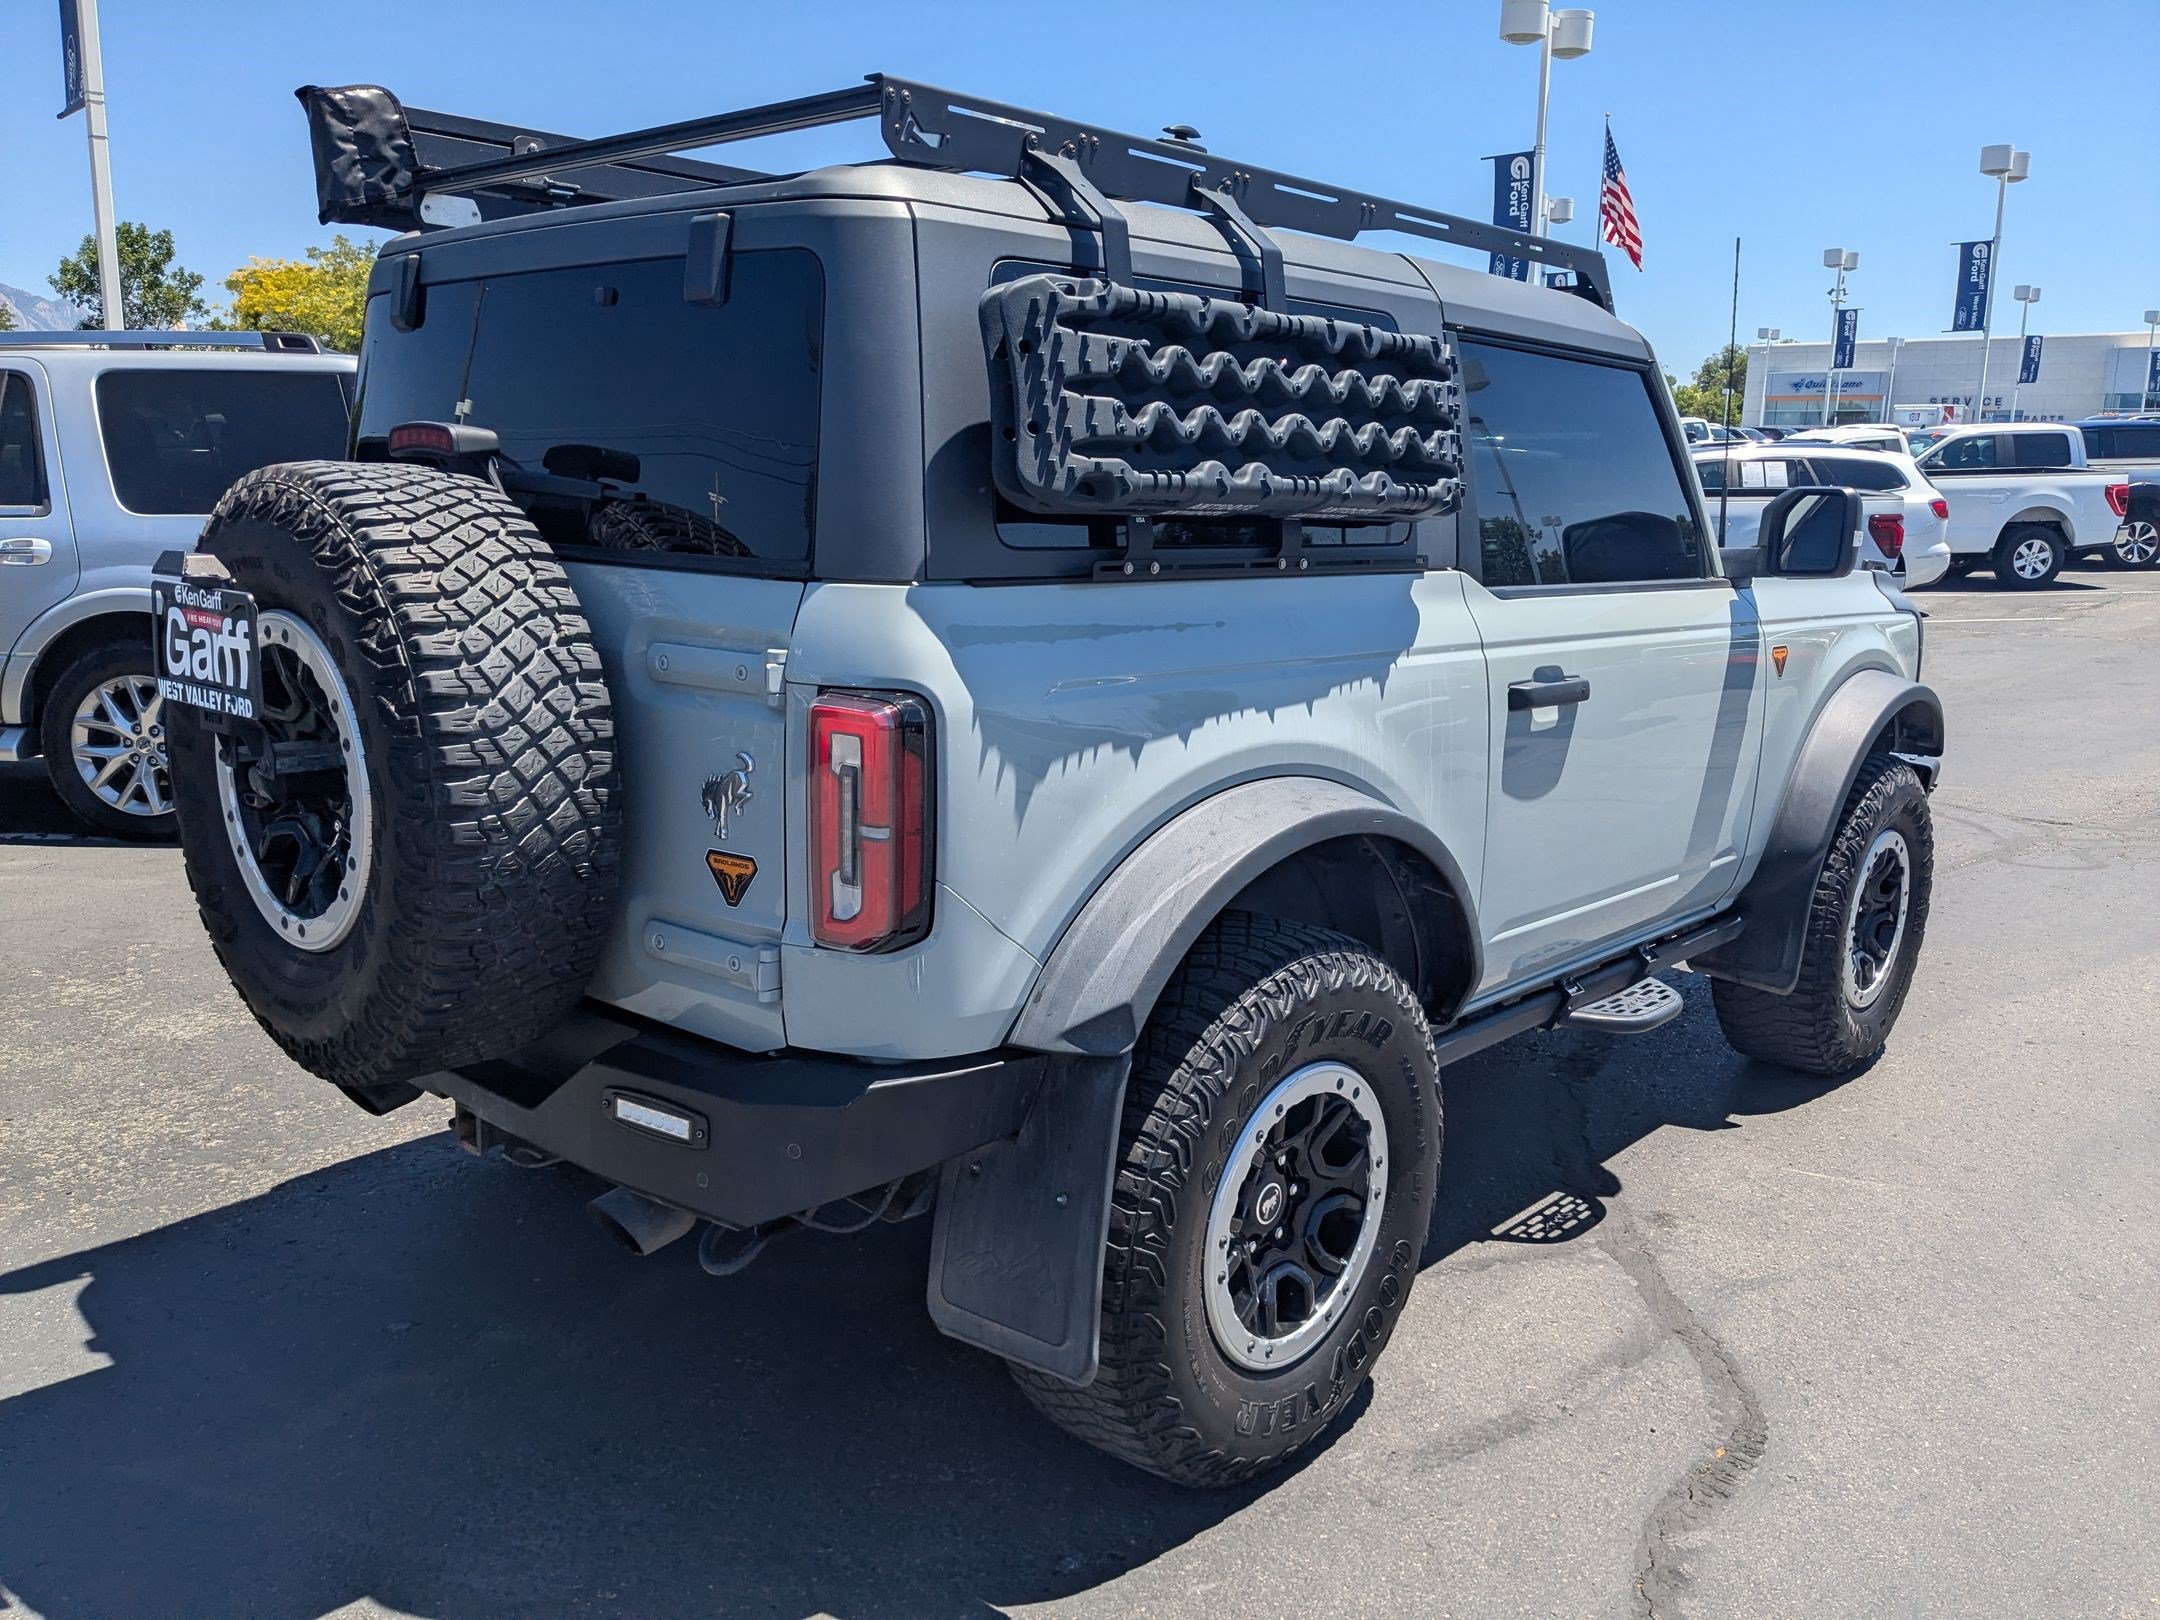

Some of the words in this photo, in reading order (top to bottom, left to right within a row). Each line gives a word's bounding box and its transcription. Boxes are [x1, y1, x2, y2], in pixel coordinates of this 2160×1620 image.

[1510, 182, 1520, 216] Ford
[1520, 180, 1530, 200] Ken
[1520, 202, 1528, 228] Garff
[1970, 260, 1980, 282] Ford
[1930, 398, 2002, 406] SERVCE
[182, 586, 199, 605] Ken
[200, 589, 222, 610] Garff
[166, 606, 250, 690] Garff
[158, 678, 184, 701] WEST
[185, 684, 222, 711] VALLEY
[225, 695, 252, 718] FORD
[714, 857, 749, 869] BADLANDS
[1234, 1240, 1412, 1439] GOODYEAR
